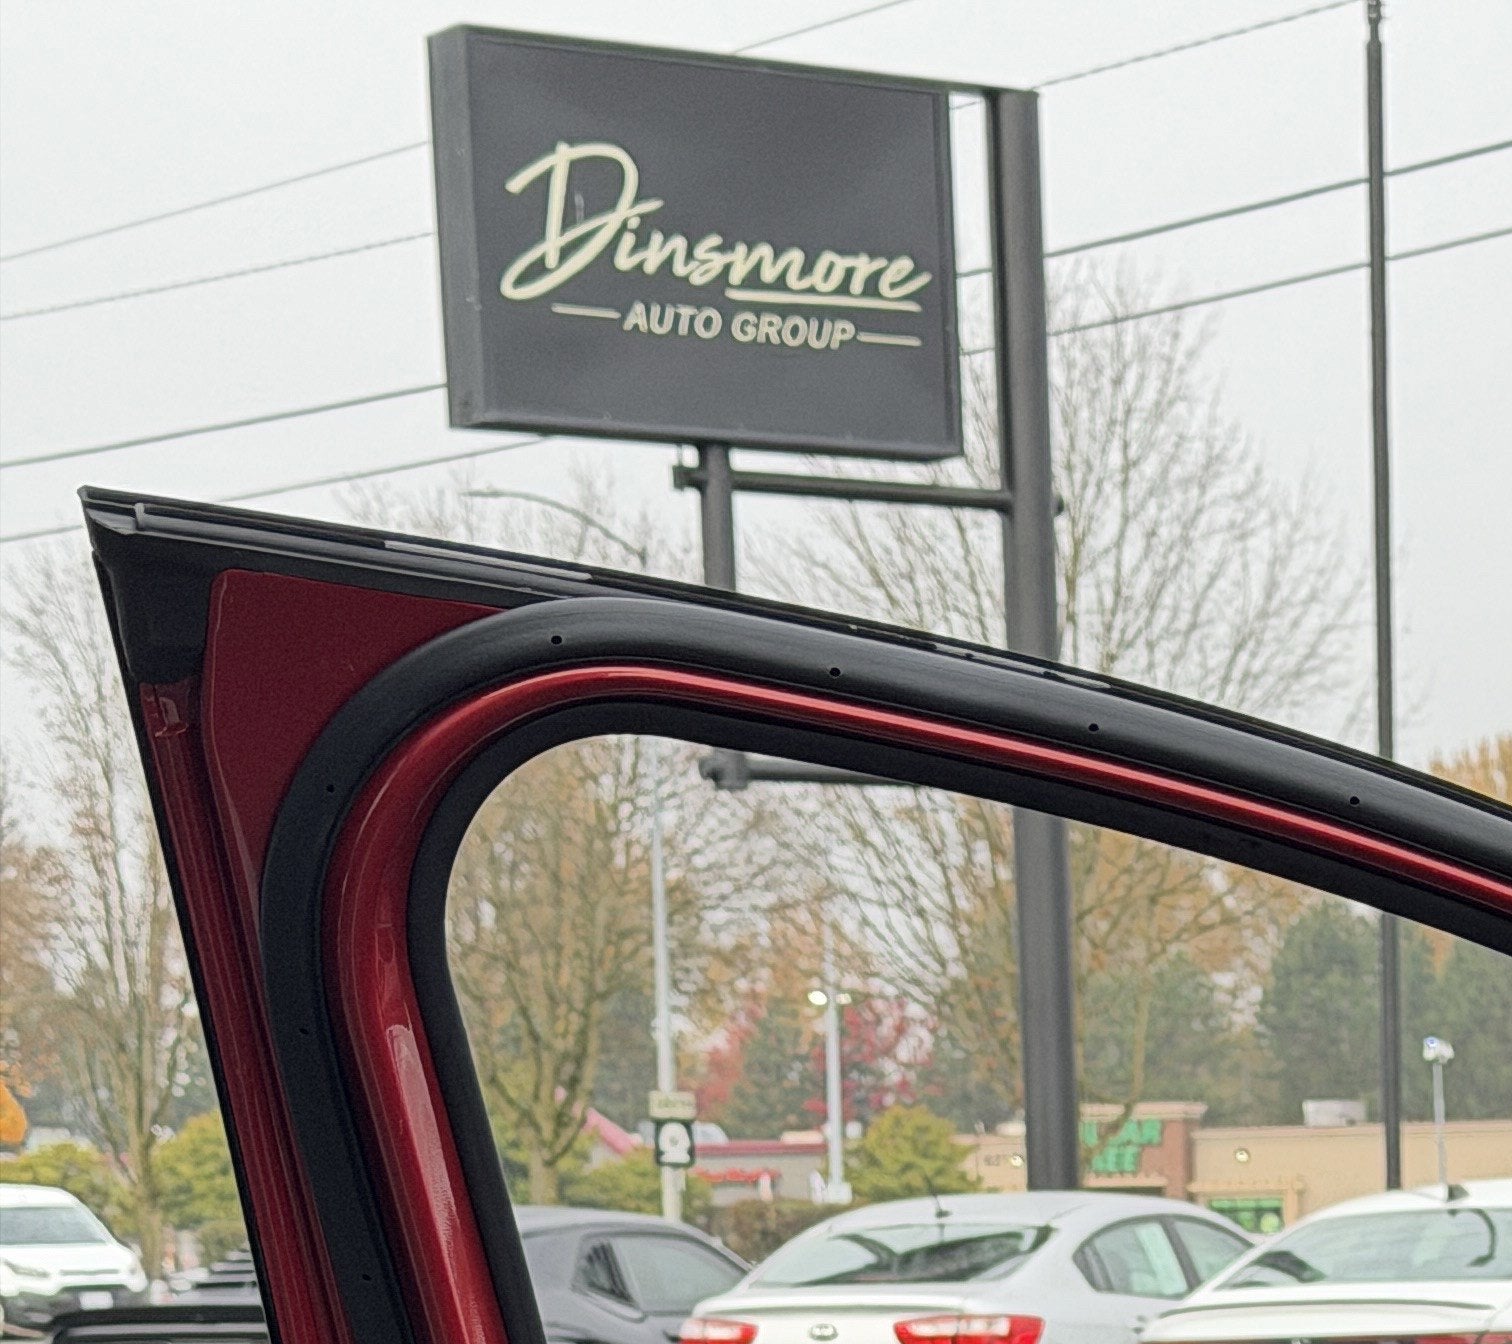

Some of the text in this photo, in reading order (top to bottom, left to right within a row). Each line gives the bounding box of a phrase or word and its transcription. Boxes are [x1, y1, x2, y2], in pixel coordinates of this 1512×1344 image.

[500, 141, 932, 300] Dinsmore
[622, 301, 856, 350] AUTO GROUP
